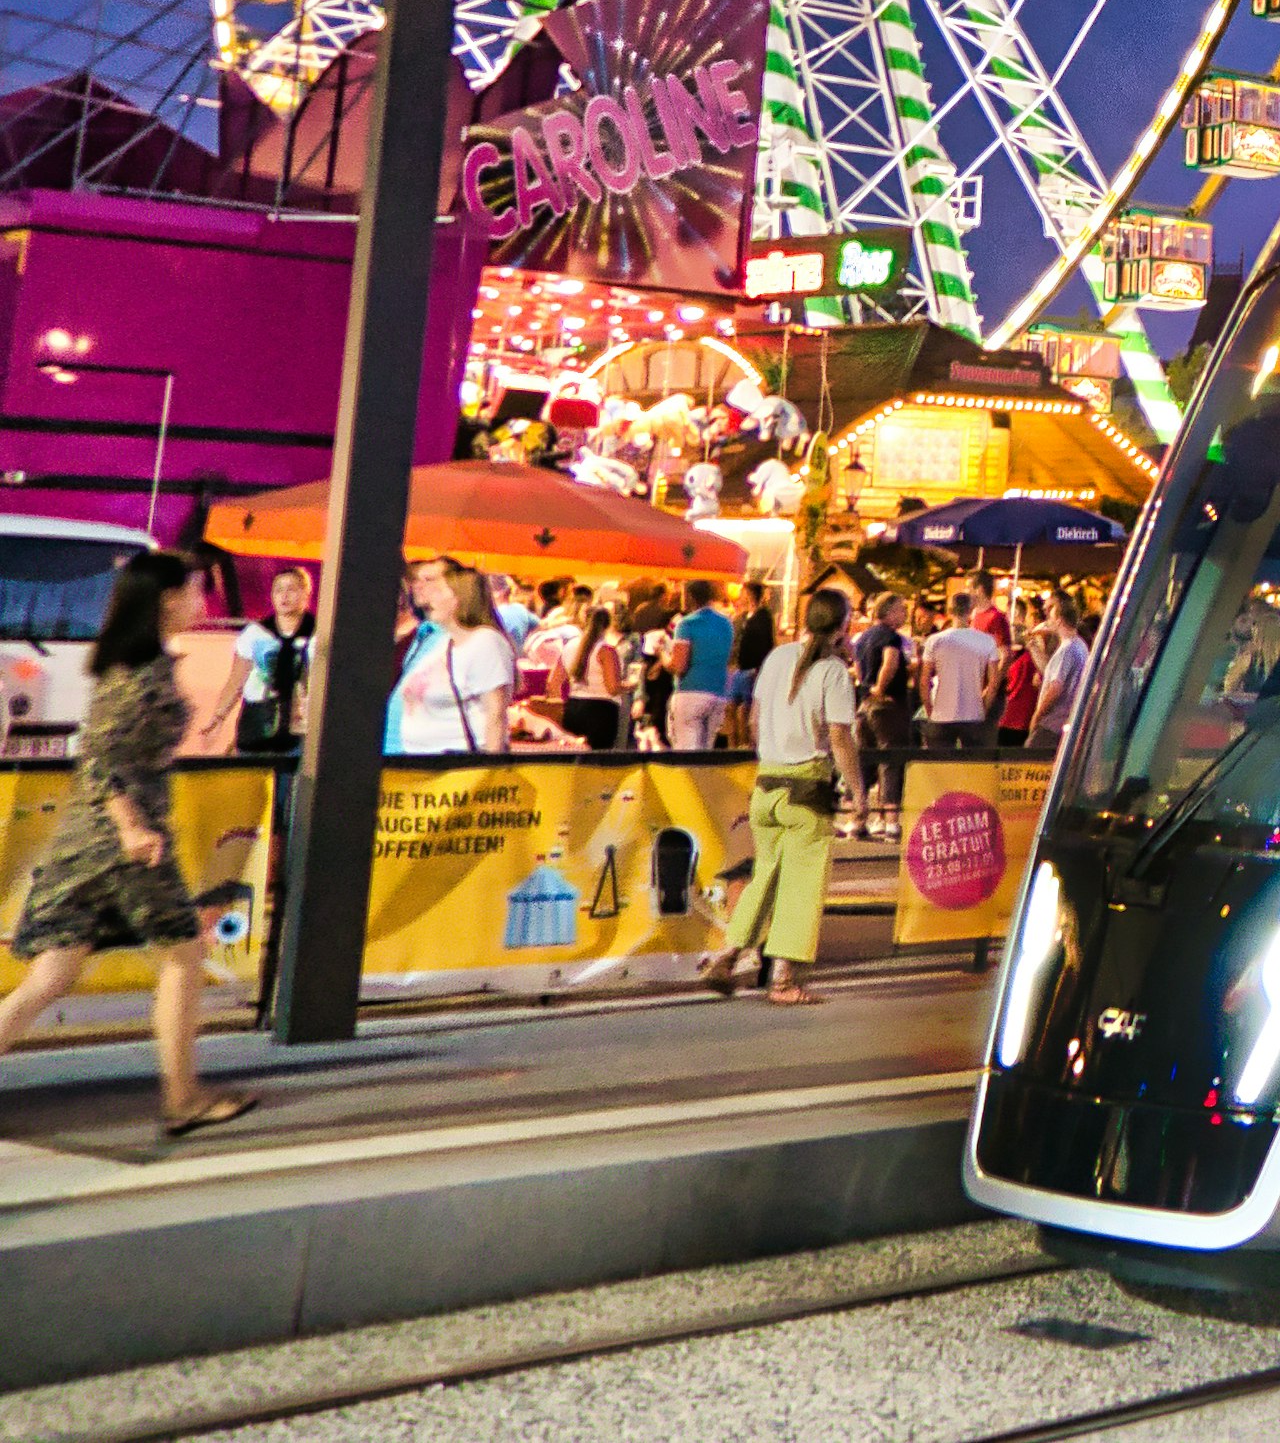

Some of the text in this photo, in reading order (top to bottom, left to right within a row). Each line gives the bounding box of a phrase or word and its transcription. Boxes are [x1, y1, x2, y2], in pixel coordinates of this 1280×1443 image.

[463, 59, 760, 241] CAROLINE
[1056, 526, 1099, 541] Diekirch
[411, 789, 470, 809] TRAM
[477, 809, 542, 829] OHREN
[920, 810, 989, 843] LE TRAM
[921, 831, 992, 863] GRATUIT
